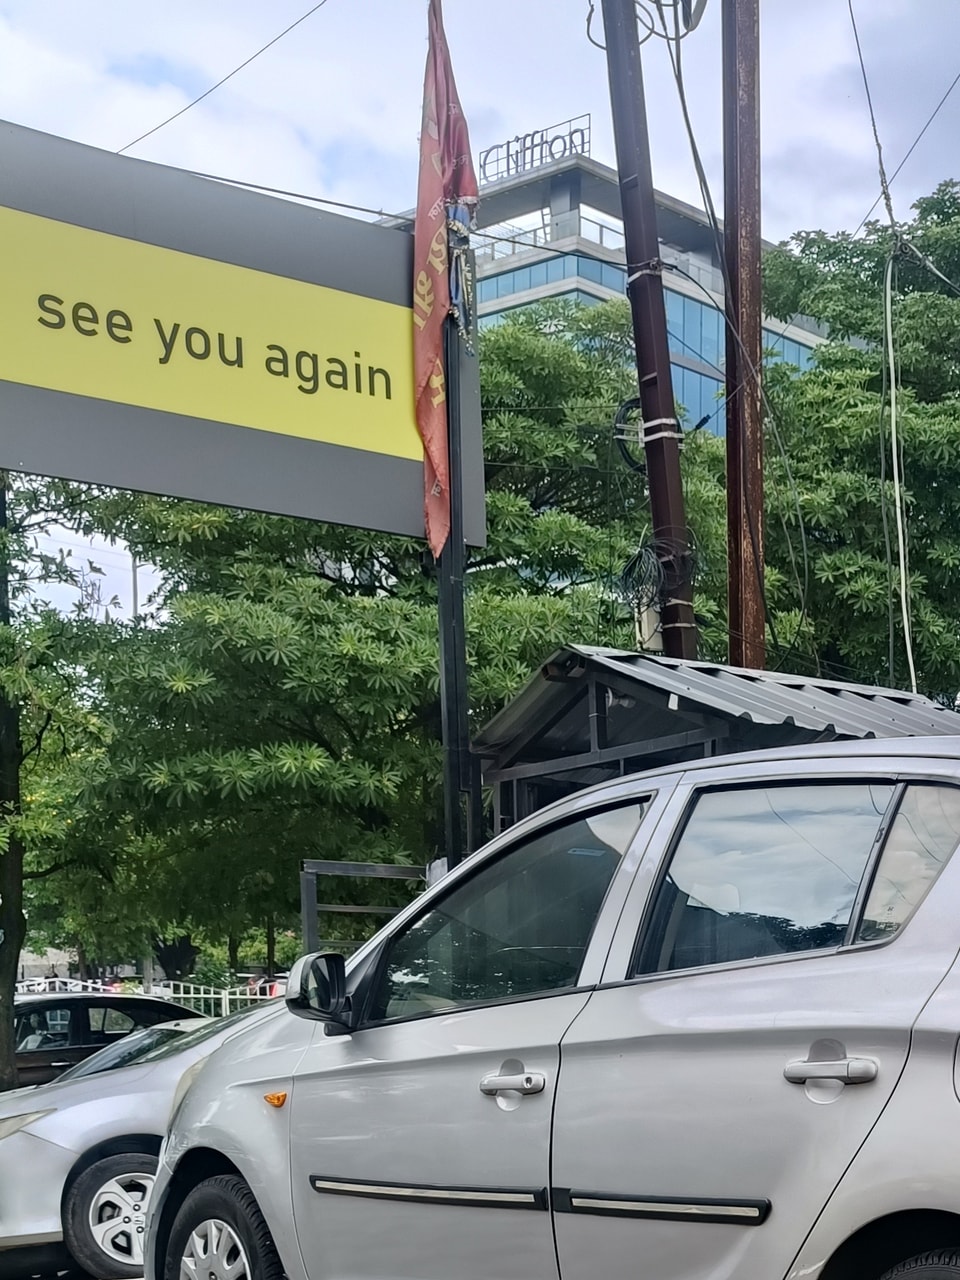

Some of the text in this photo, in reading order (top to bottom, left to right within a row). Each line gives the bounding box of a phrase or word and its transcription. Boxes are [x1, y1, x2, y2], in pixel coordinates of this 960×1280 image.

[37, 293, 133, 344] see
[153, 317, 243, 368] you
[264, 343, 392, 400] again
